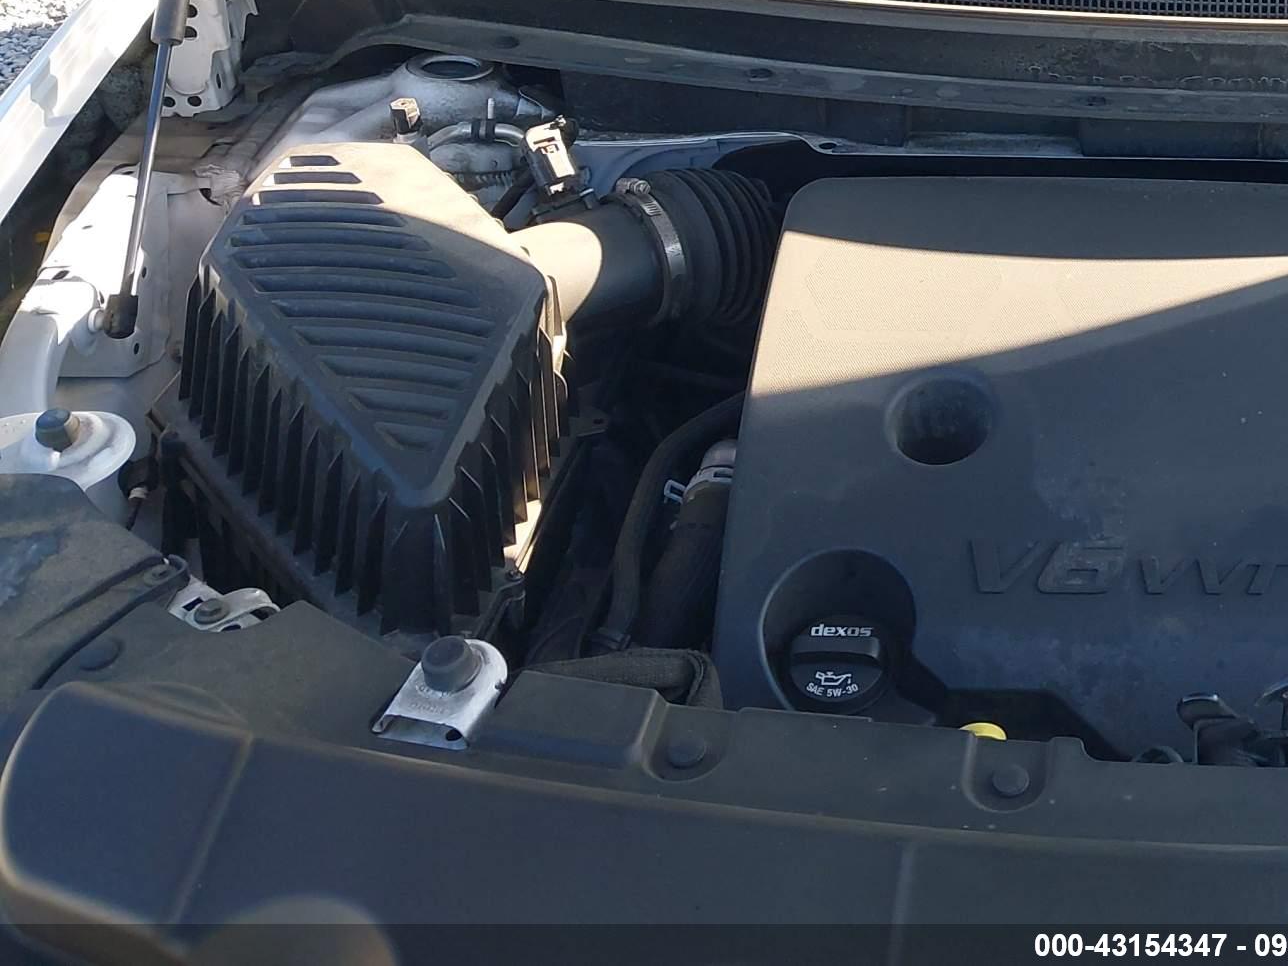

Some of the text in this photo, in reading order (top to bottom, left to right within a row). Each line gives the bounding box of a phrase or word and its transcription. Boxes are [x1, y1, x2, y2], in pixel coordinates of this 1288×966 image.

[968, 537, 1127, 594] V6
[810, 623, 874, 637] dexos
[806, 682, 859, 698] SAE 5W-30
